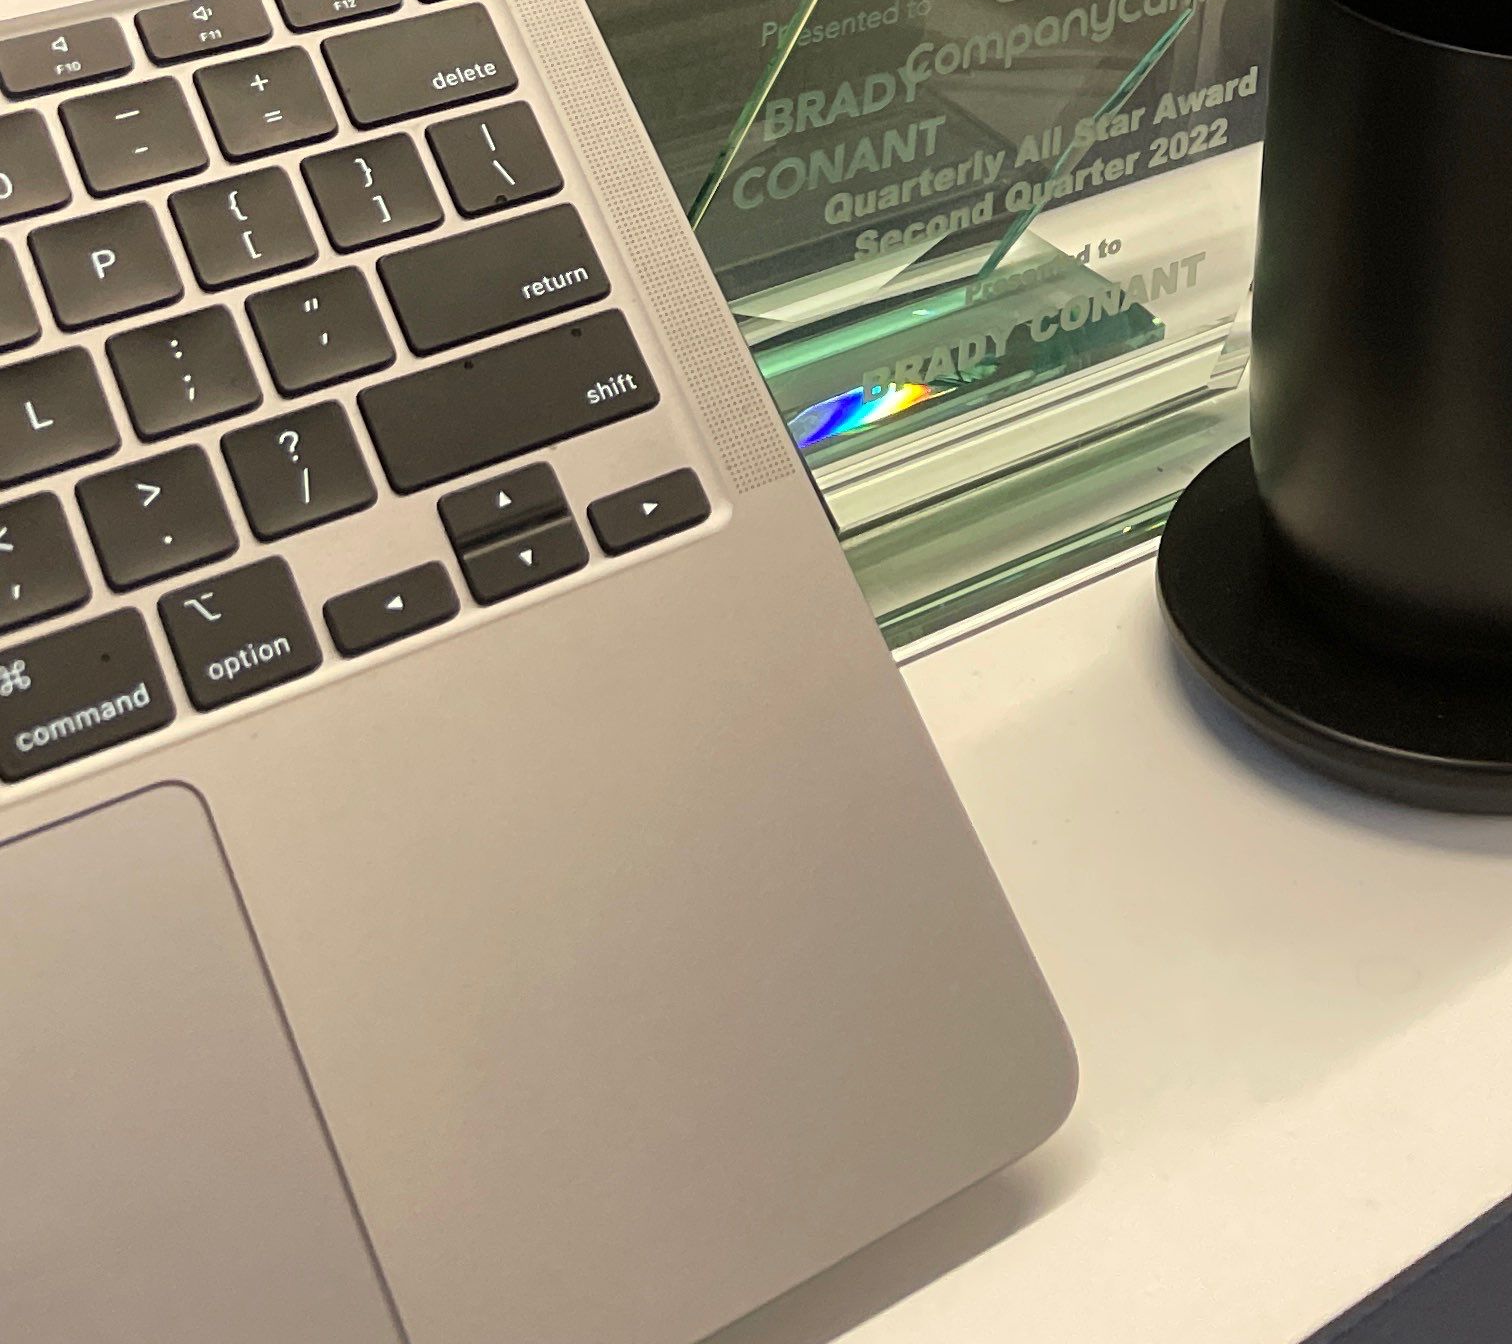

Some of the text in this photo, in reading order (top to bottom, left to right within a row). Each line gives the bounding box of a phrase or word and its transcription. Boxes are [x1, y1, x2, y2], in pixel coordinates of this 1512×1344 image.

[200, 29, 222, 43] F11
[56, 60, 82, 76] F10
[432, 58, 498, 92] delete
[762, 63, 926, 143] BRADY
[732, 115, 947, 210] CONANT
[824, 65, 1259, 225] Quarterly All Star Award
[853, 117, 1229, 262] Second Quarter 2022
[90, 248, 117, 279] P
[1097, 237, 1122, 259] to
[521, 264, 590, 301] return
[861, 251, 1207, 404] BRADY CONANT
[585, 372, 639, 406] shift
[25, 401, 54, 431] L
[207, 635, 291, 682] option
[15, 682, 151, 753] command
